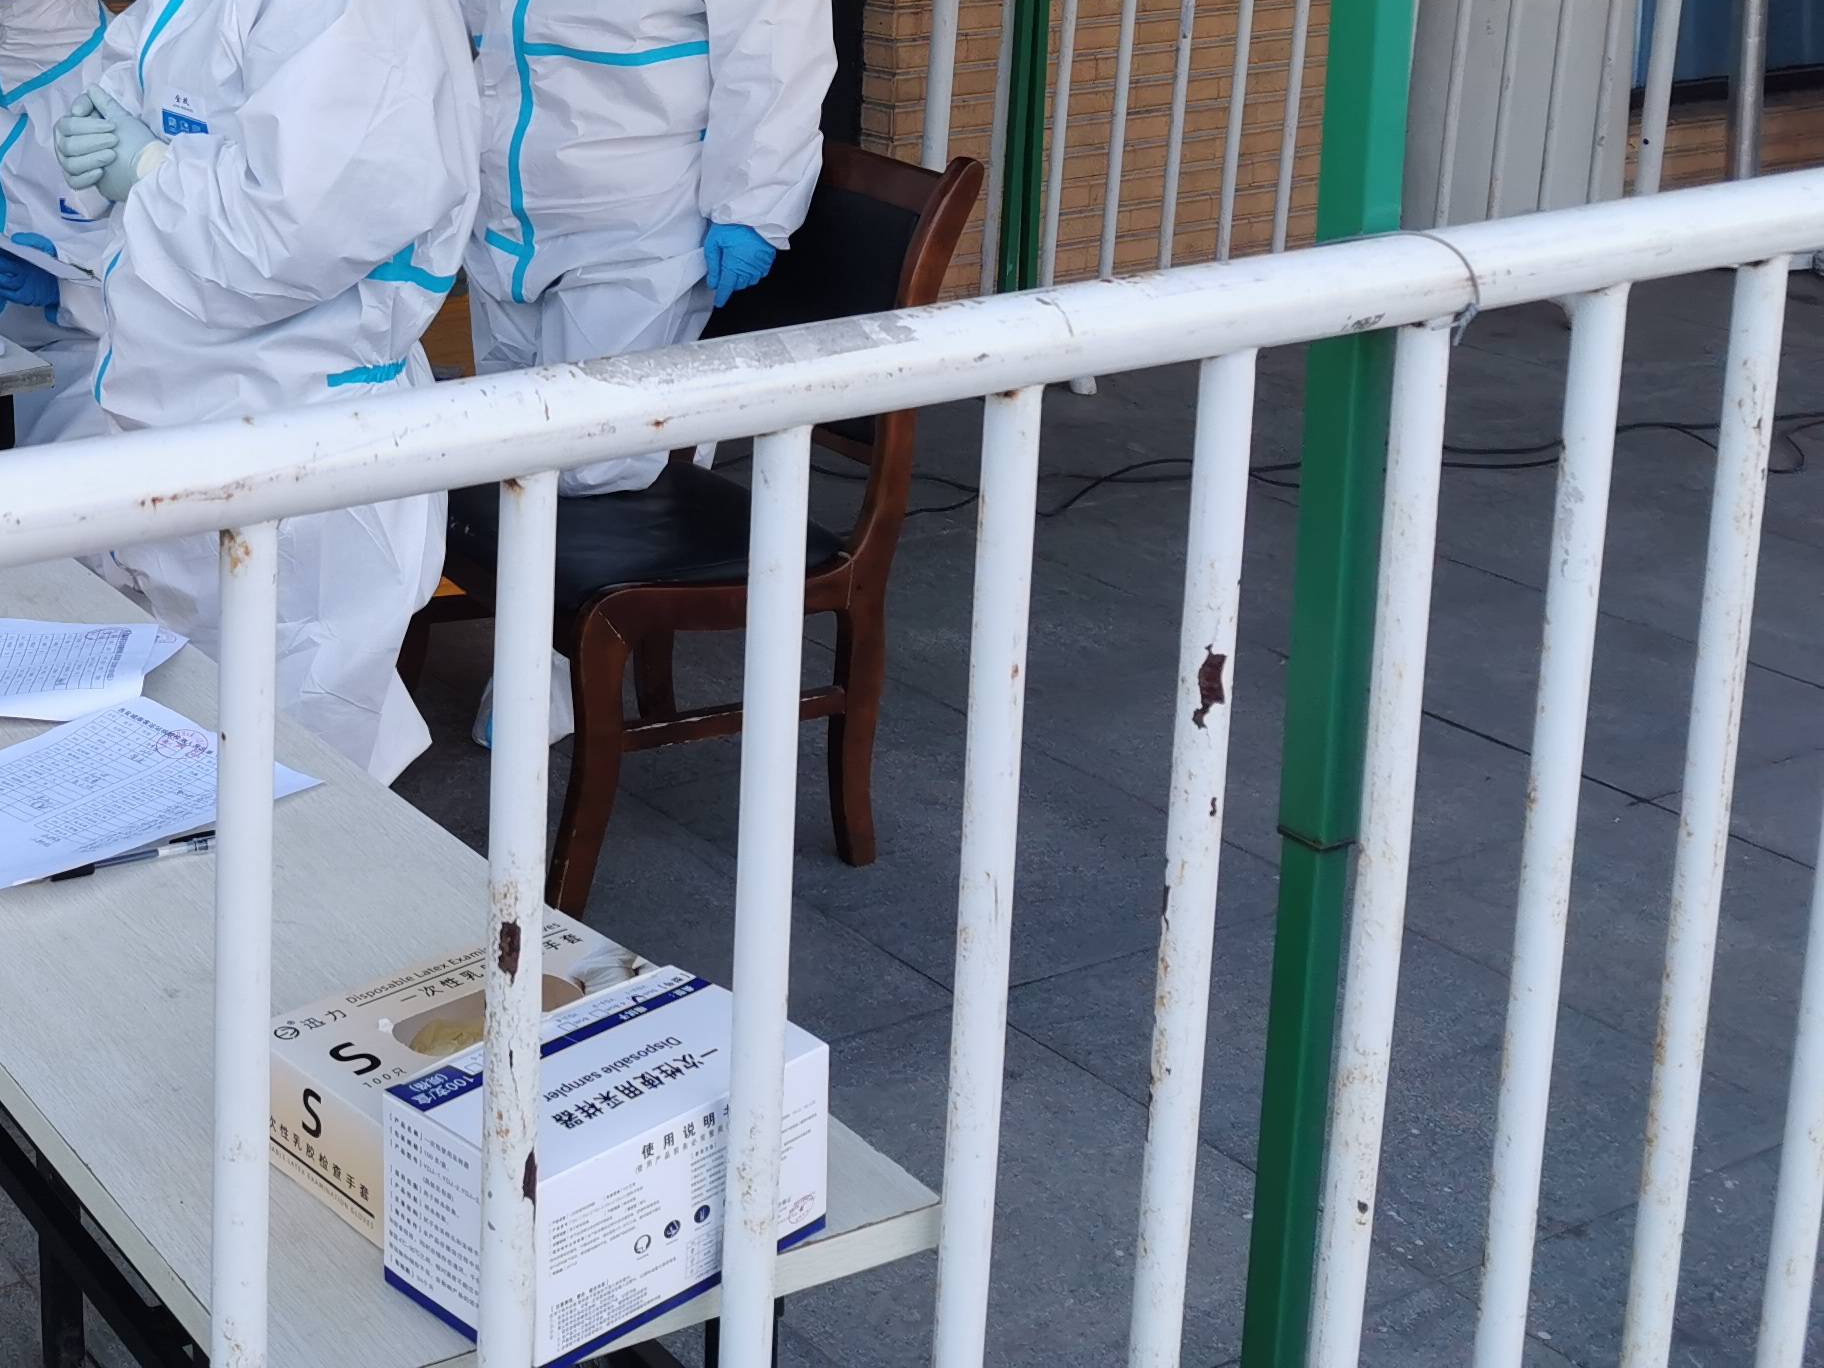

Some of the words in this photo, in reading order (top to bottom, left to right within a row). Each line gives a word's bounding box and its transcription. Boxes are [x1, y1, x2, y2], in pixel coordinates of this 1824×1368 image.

[345, 975, 415, 1005] Disposable
[415, 962, 447, 979] Latex
[447, 946, 487, 966] Exami
[300, 1008, 347, 1030] 迅力
[329, 1041, 382, 1076] S
[600, 1035, 684, 1074] Disposable
[362, 1066, 408, 1090] 100只
[543, 1072, 603, 1103] sampler
[550, 1047, 720, 1130] 一次性使用采样器
[301, 1088, 323, 1139] S
